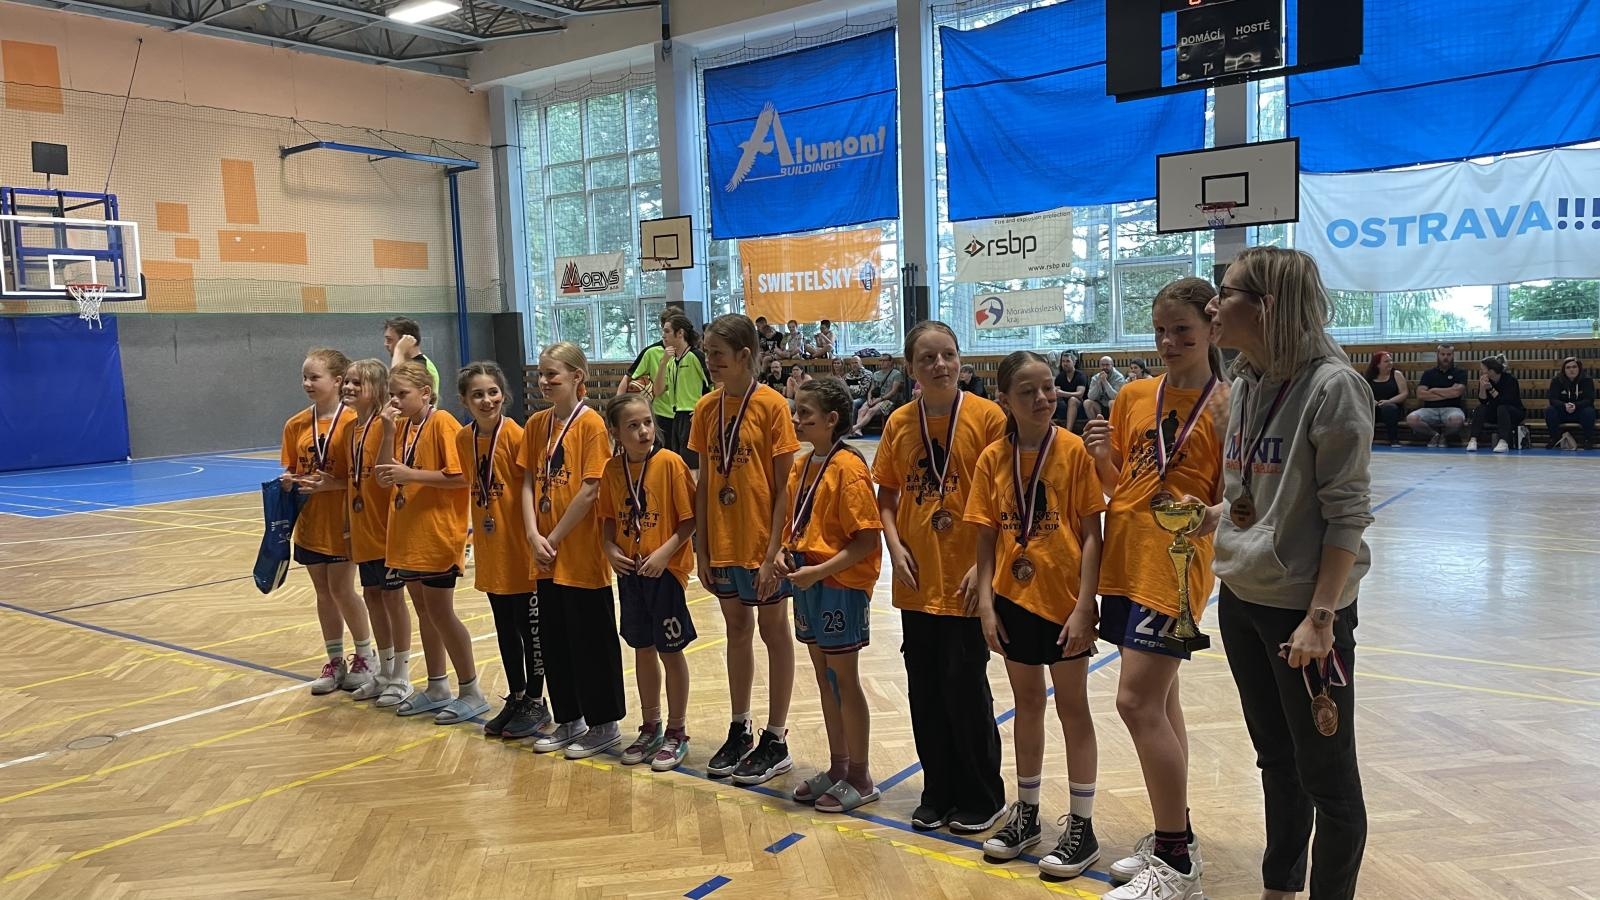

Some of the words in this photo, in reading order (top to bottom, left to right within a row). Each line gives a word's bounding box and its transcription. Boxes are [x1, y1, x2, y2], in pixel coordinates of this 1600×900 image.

[1181, 29, 1221, 45] DOMÁCÍ
[780, 162, 830, 177] BUILDING
[987, 230, 1037, 259] rsbp
[758, 267, 852, 294] SWIETELSKY
[663, 616, 682, 640] 30
[821, 608, 846, 634] 23
